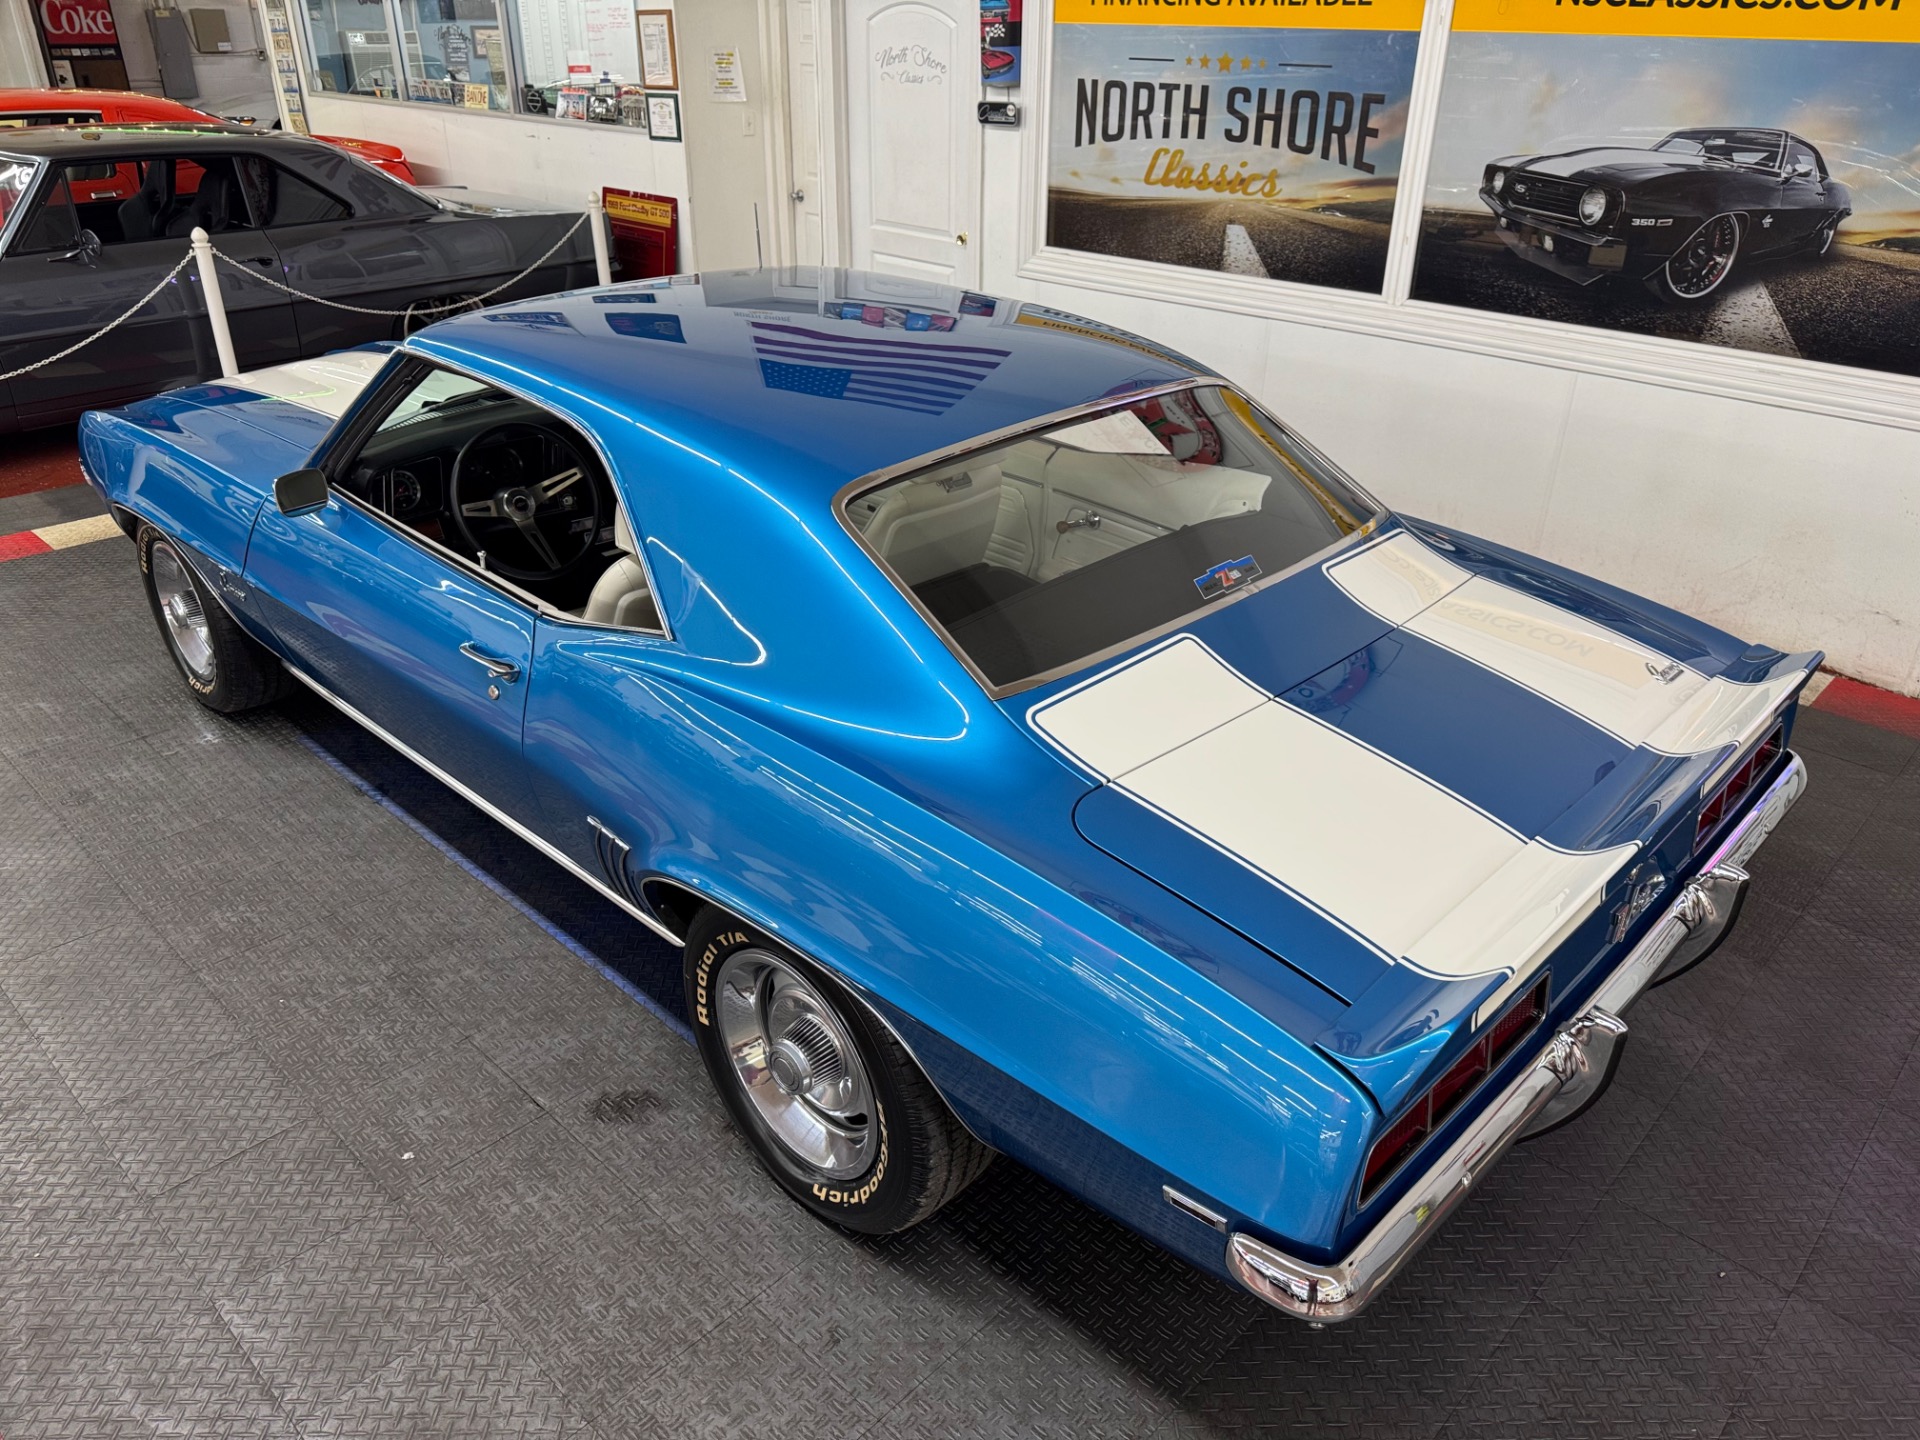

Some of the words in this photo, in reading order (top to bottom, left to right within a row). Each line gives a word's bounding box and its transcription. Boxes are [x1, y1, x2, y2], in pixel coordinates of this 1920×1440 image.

[40, 0, 115, 34] Coke
[875, 46, 908, 69] North
[911, 44, 947, 74] Shore
[897, 70, 924, 84] Classics
[1074, 77, 1210, 147] NORTH
[1224, 86, 1386, 175] SHORE
[1143, 148, 1283, 198] Classics
[650, 206, 658, 216] GT
[1631, 218, 1656, 227] 350
[696, 943, 718, 1026] Radial
[716, 931, 750, 946] T/A
